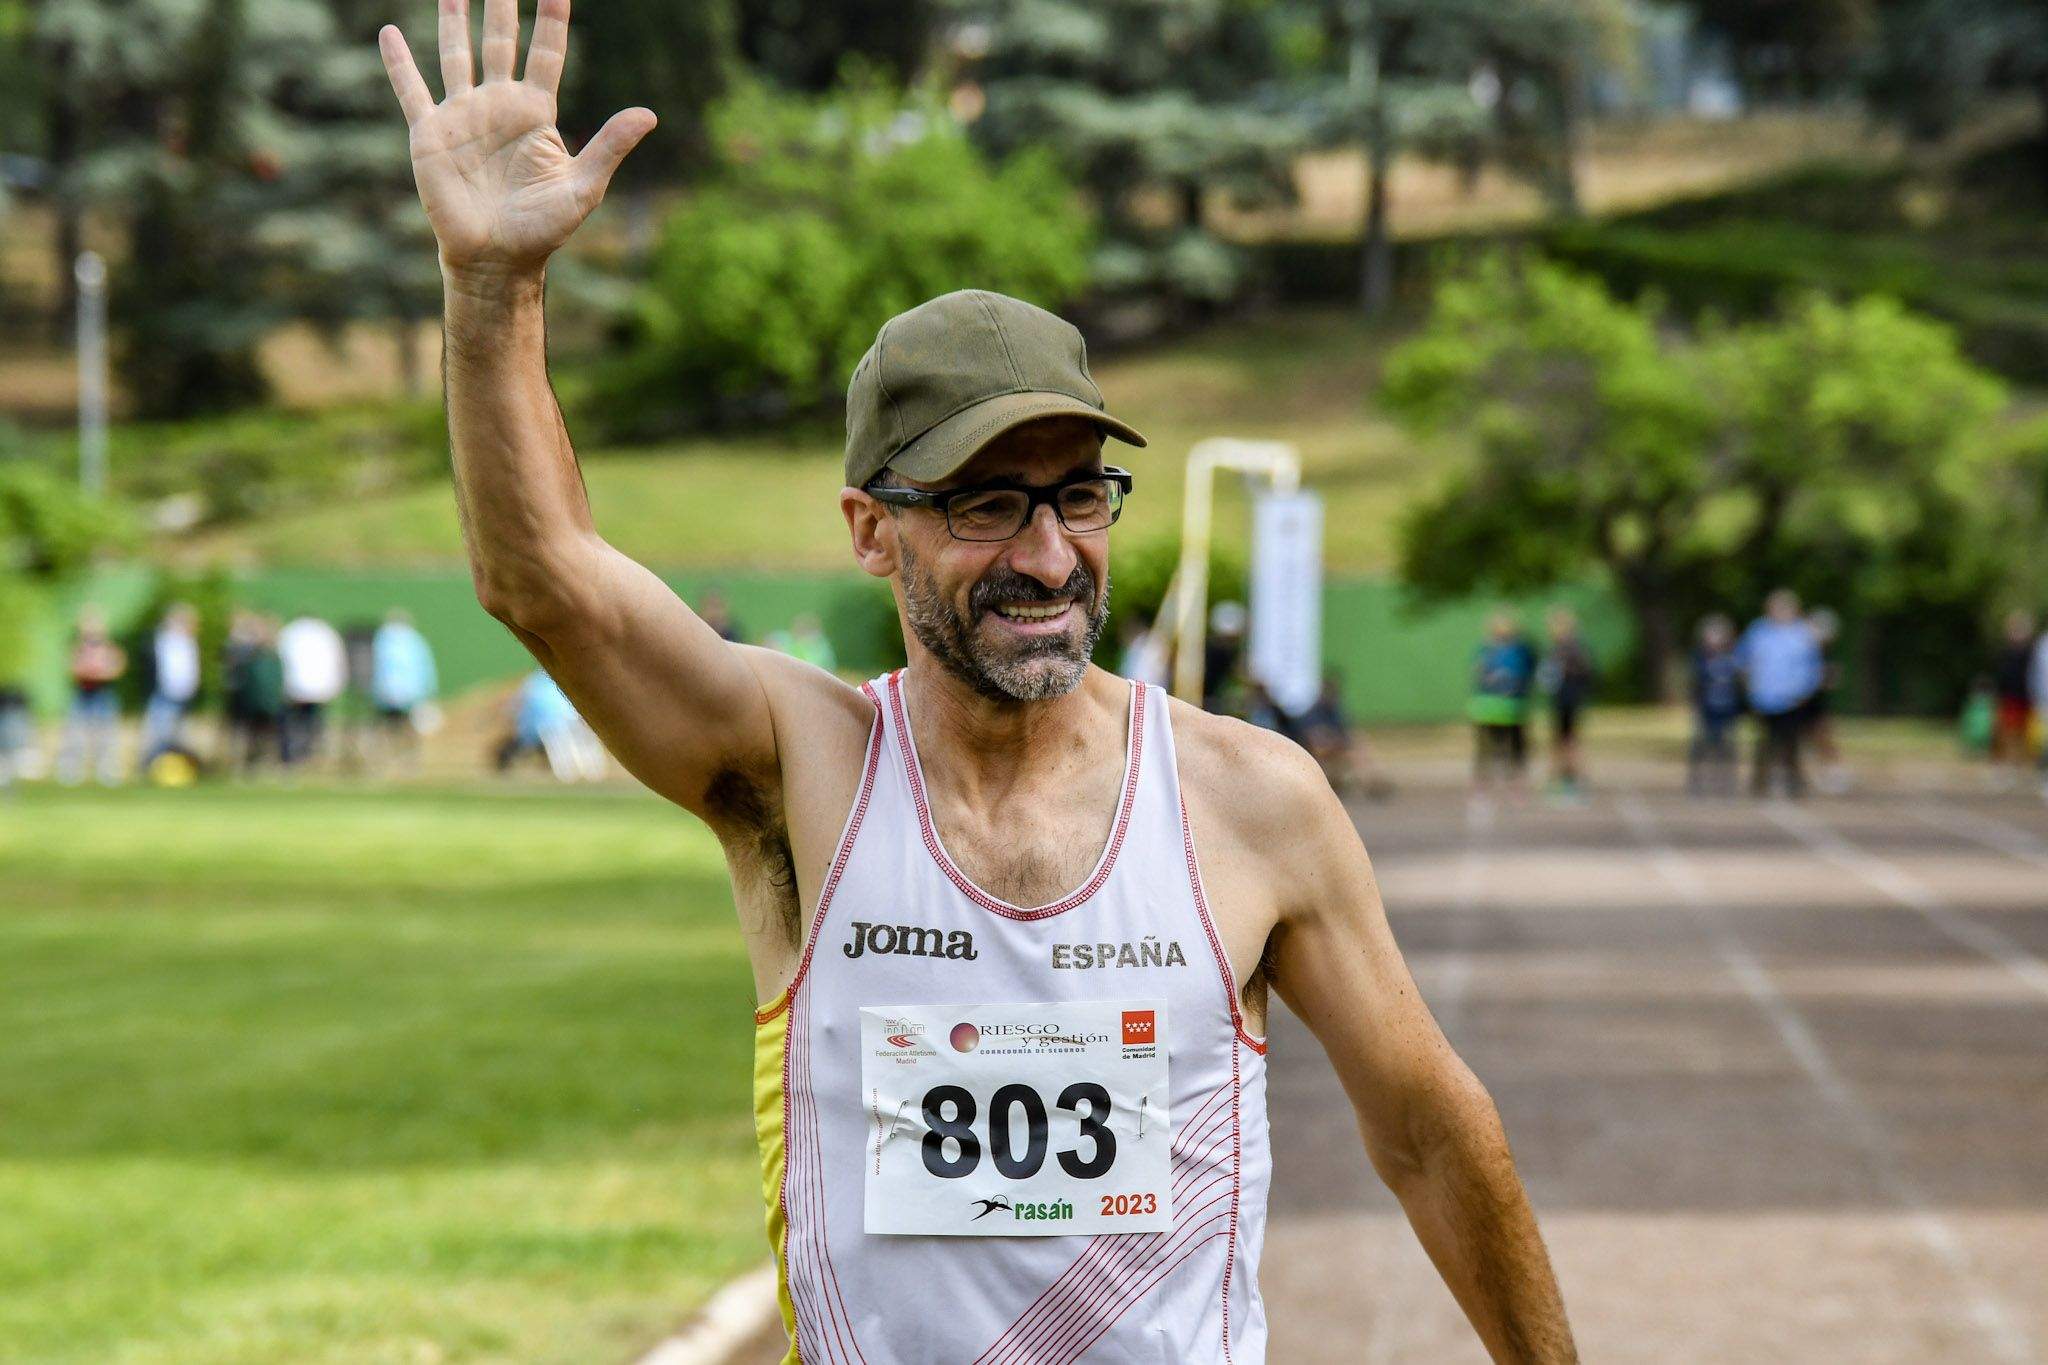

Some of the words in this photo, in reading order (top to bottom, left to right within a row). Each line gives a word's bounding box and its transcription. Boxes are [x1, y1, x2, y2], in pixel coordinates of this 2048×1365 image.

[843, 921, 978, 961] Joma
[1052, 936, 1187, 970] ESPAÑA
[980, 1024, 1059, 1035] RIESGO
[1022, 1036, 1032, 1048] y
[1038, 1033, 1109, 1047] gestión
[921, 1083, 1117, 1180] 803
[1015, 1198, 1073, 1220] rasán
[1101, 1194, 1157, 1216] 2023
